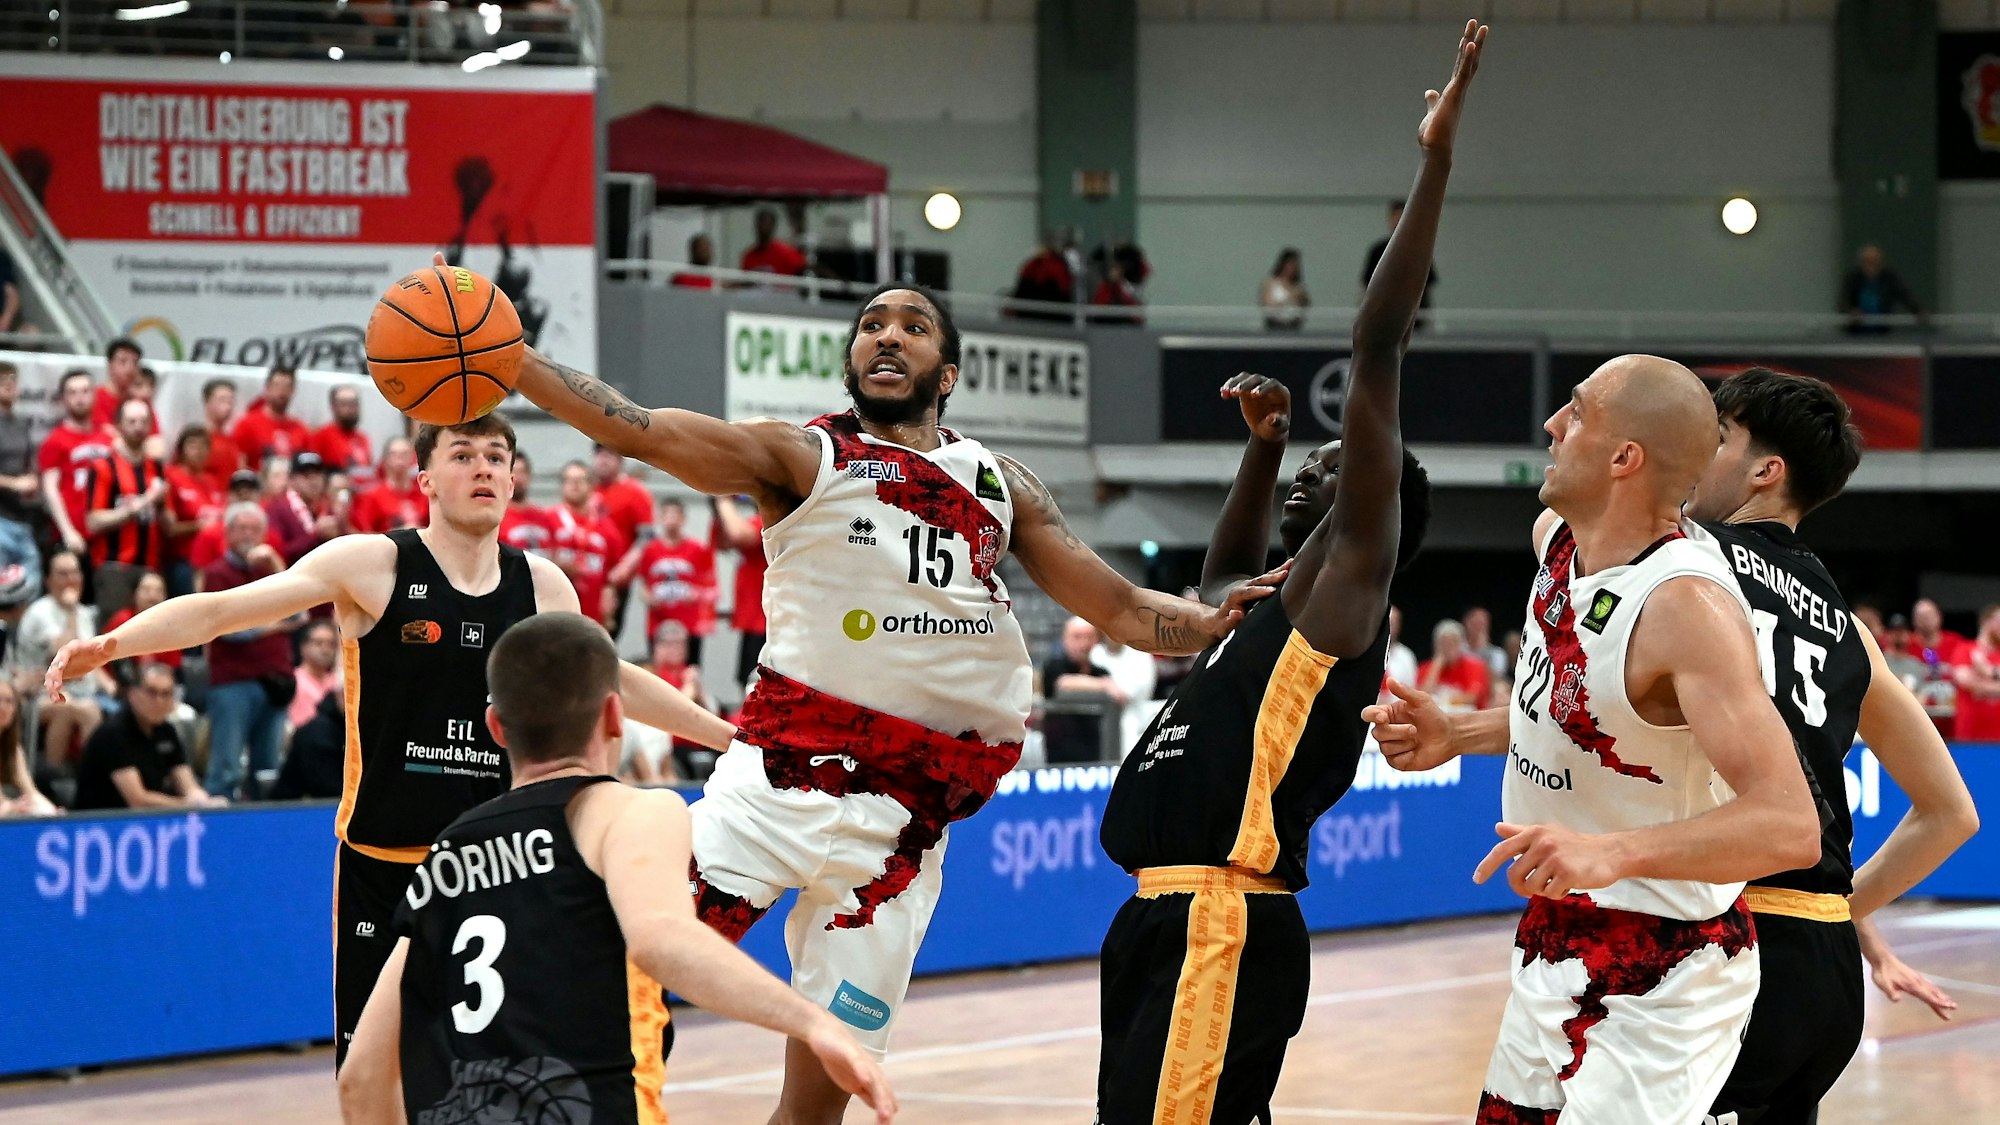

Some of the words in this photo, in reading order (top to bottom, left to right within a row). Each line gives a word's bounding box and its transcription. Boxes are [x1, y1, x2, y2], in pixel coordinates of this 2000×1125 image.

[101, 93, 351, 145] DIGITALISIERUNG
[361, 100, 408, 146] IST
[101, 144, 162, 192] WIE
[169, 146, 221, 194] EIN
[229, 147, 409, 196] FASTBREAK
[149, 203, 237, 235] SCHNELL
[963, 346, 1082, 398] OTHEKE
[867, 462, 905, 481] EVL
[848, 535, 877, 546] errea
[902, 525, 955, 588] 15
[1731, 544, 1848, 643] BENNEFELD
[882, 610, 995, 635] orthomol
[1519, 646, 1551, 724] 22
[406, 741, 453, 760] Freund
[465, 747, 500, 766] Partne
[447, 719, 475, 741] ETL
[35, 812, 206, 918] sport
[992, 803, 1094, 889] sport
[1317, 801, 1401, 879] sport
[405, 828, 555, 911] DÖRING
[451, 914, 506, 1036] 3
[839, 991, 883, 1019] Barmenia
[1175, 1016, 1193, 1051] BRN
